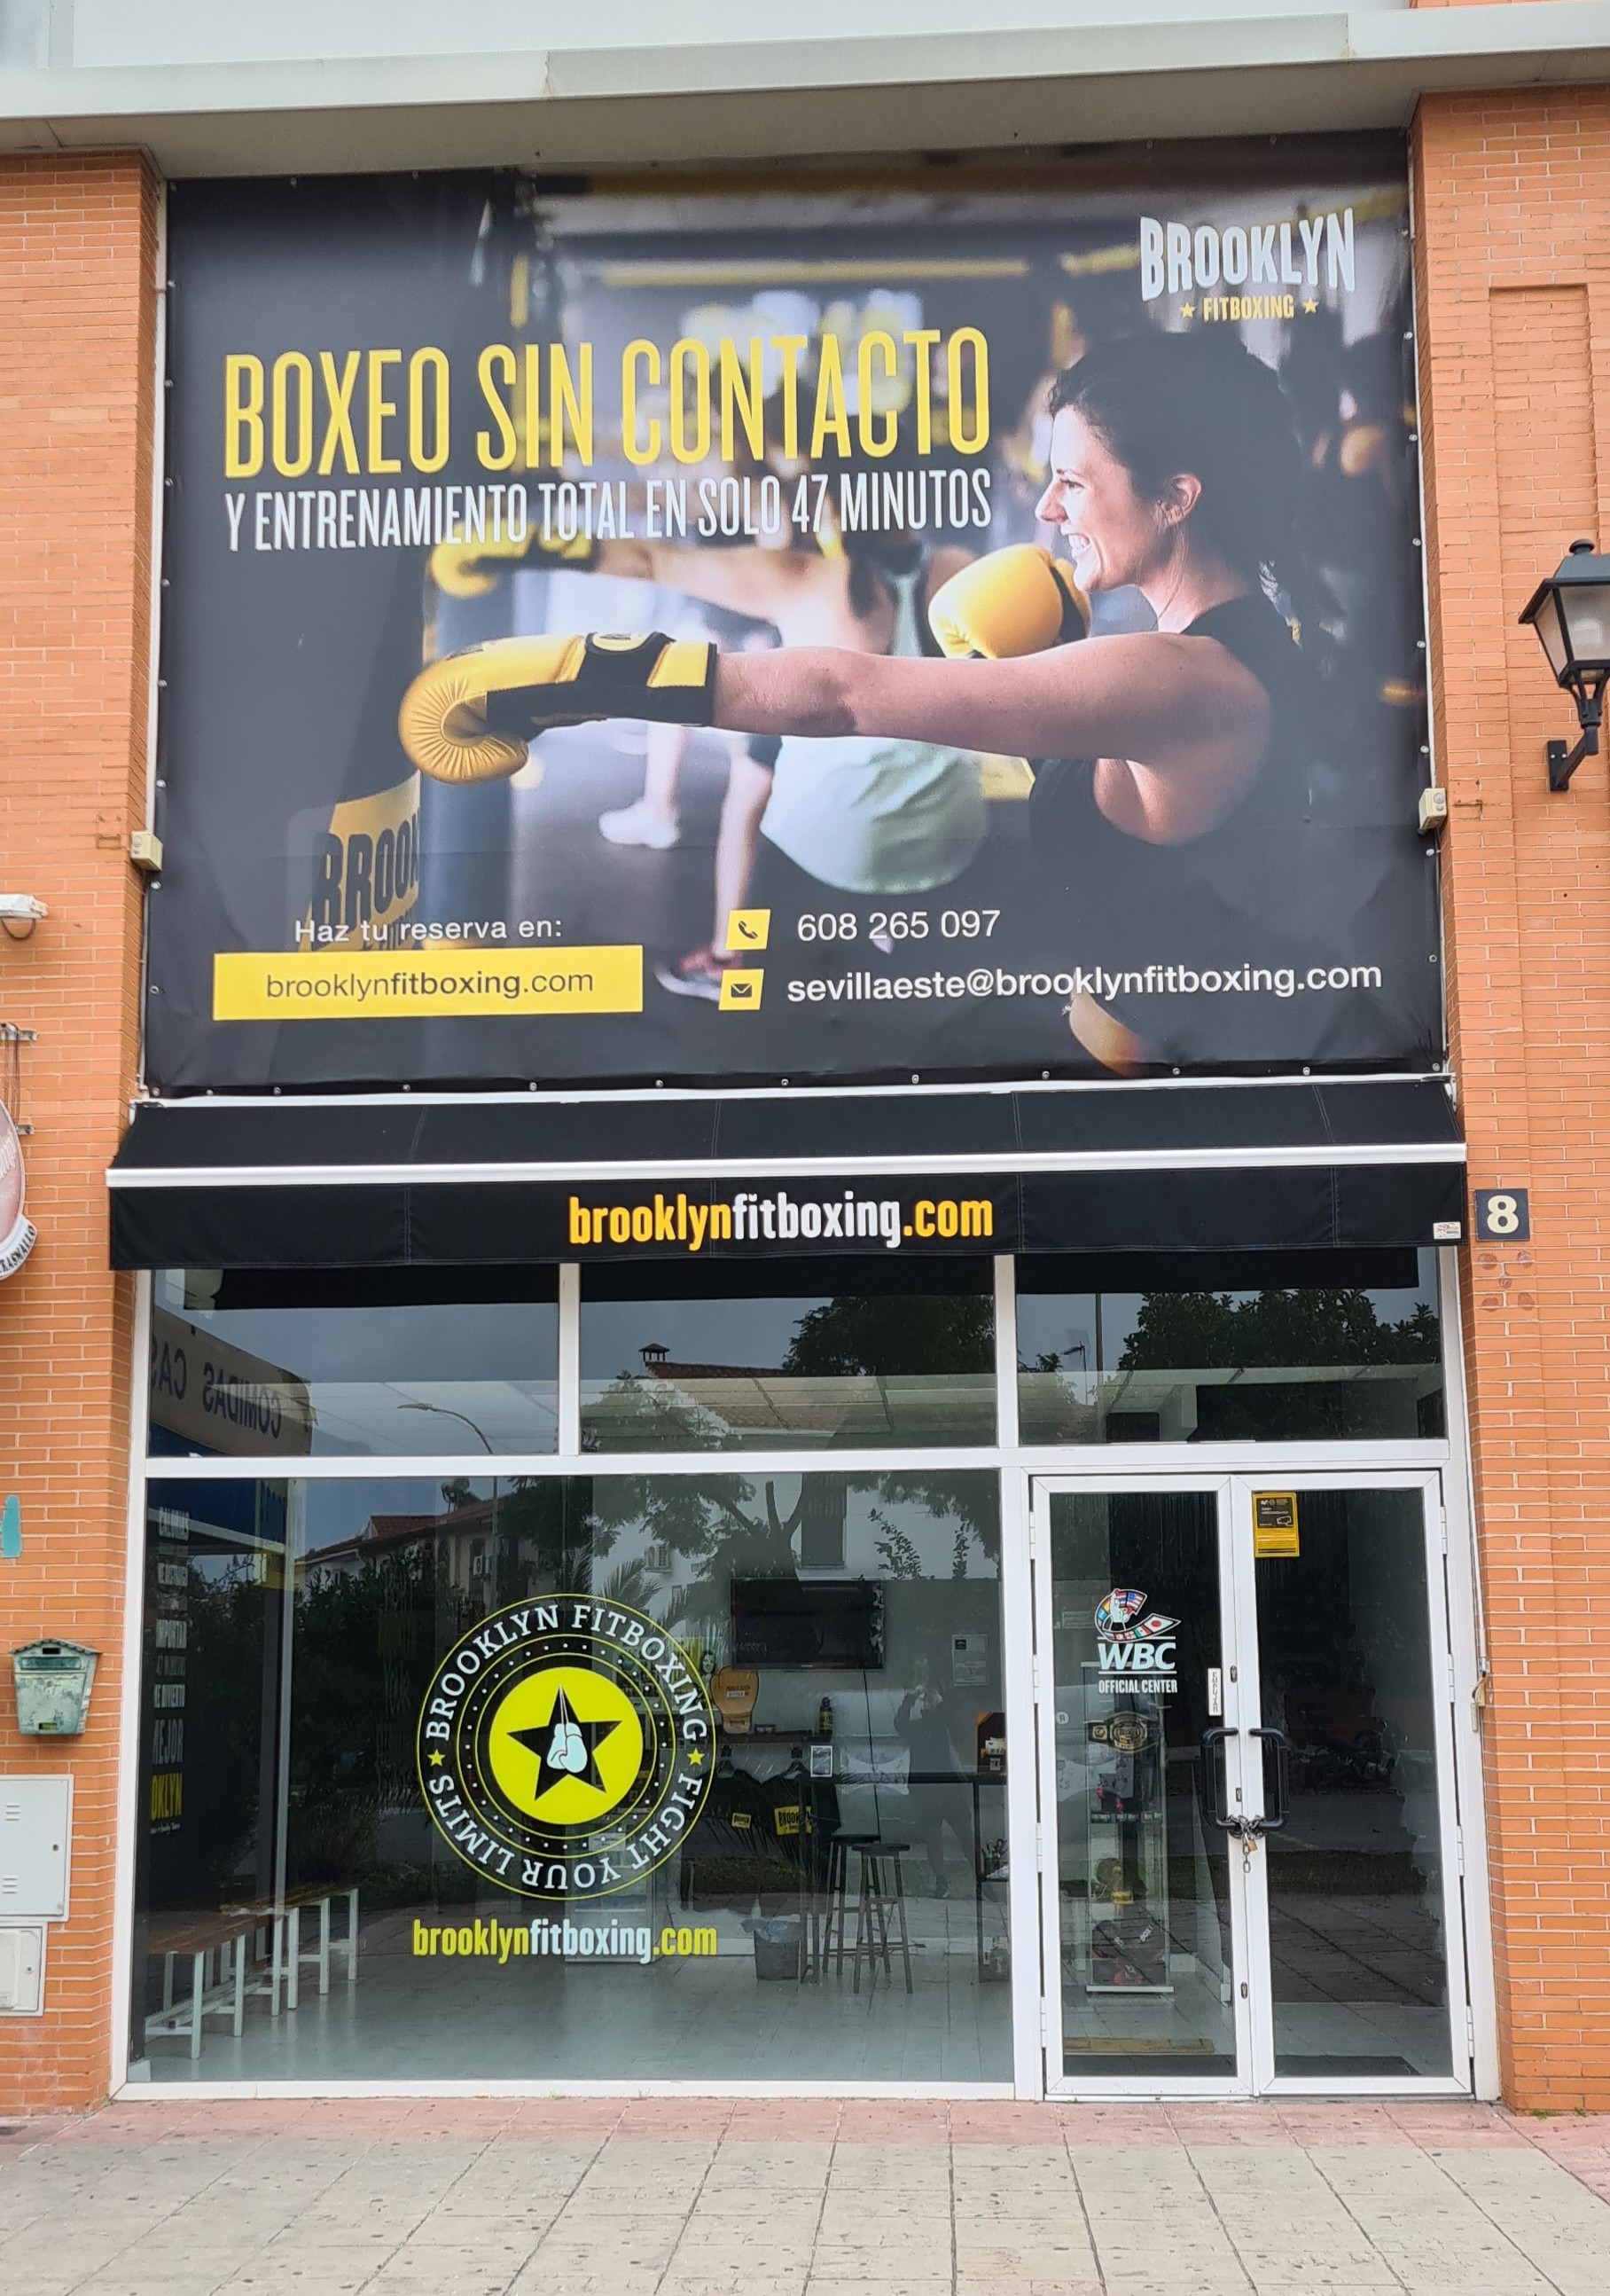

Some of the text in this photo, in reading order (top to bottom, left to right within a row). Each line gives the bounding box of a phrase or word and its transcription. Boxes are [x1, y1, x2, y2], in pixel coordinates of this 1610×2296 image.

[1139, 208, 1356, 302] BROOKLYN
[1202, 294, 1295, 321] FITBOXING
[224, 325, 991, 479] BOXEO SIN CONTACTO
[224, 466, 992, 552] Y ENTRENAMIENTO TOTAL EN SOLO 47 MINUTOS
[294, 920, 349, 944] Haz
[361, 919, 388, 941] tu
[400, 921, 507, 941] reserva
[518, 918, 562, 938] en:
[796, 910, 1001, 942] 608 265 097
[266, 970, 594, 1003] brooklynfitboxing.com
[786, 963, 1382, 1003] sevillaeste@brooklynfitboxing.com
[568, 1190, 993, 1251] brooklynfitboxing.com
[1487, 1195, 1519, 1234] 8
[425, 1604, 707, 1742] BROOKLYN FITBOXING
[1098, 1642, 1176, 1670] WBC
[1098, 1678, 1177, 1694] OFFICIAL CENTER
[429, 1773, 703, 1890] FIGHT YOUR LIMITS
[412, 1918, 717, 1964] brooklynfitboxing.com
